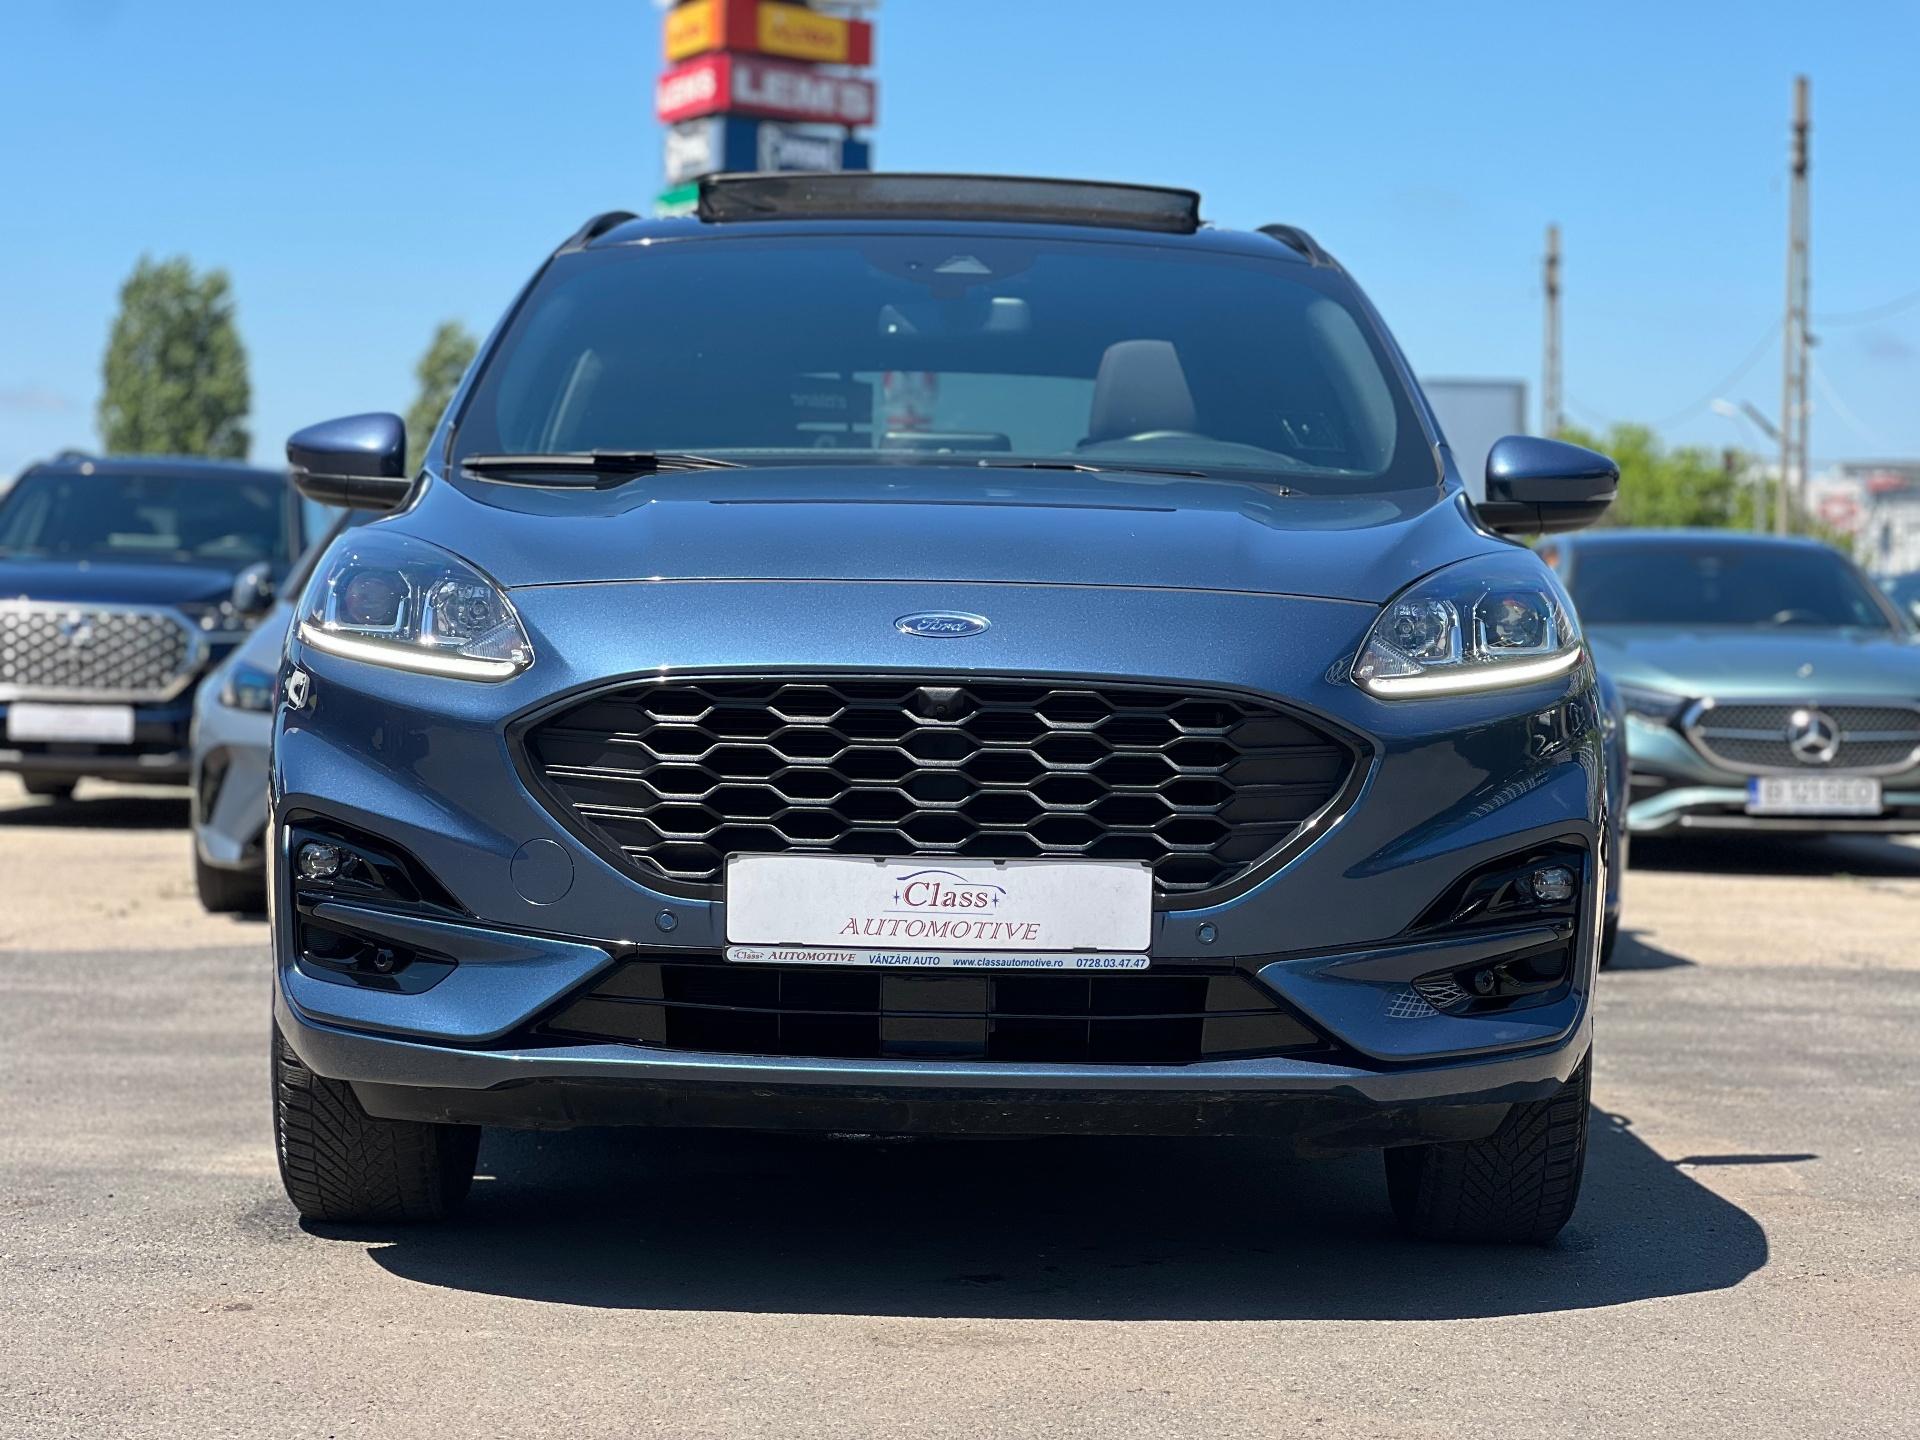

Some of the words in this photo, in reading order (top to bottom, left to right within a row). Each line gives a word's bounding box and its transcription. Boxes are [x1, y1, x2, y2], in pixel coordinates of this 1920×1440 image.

[917, 618, 967, 631] Ford
[903, 881, 988, 908] Class
[839, 917, 1041, 940] AUTOMOTIVE
[736, 950, 760, 960] Class
[768, 951, 856, 962] AUTOMOTIVE
[913, 956, 940, 966] AUTO
[952, 957, 1064, 968] www.classautomotive.ro
[1076, 958, 1147, 968] 0728.03.47.47
